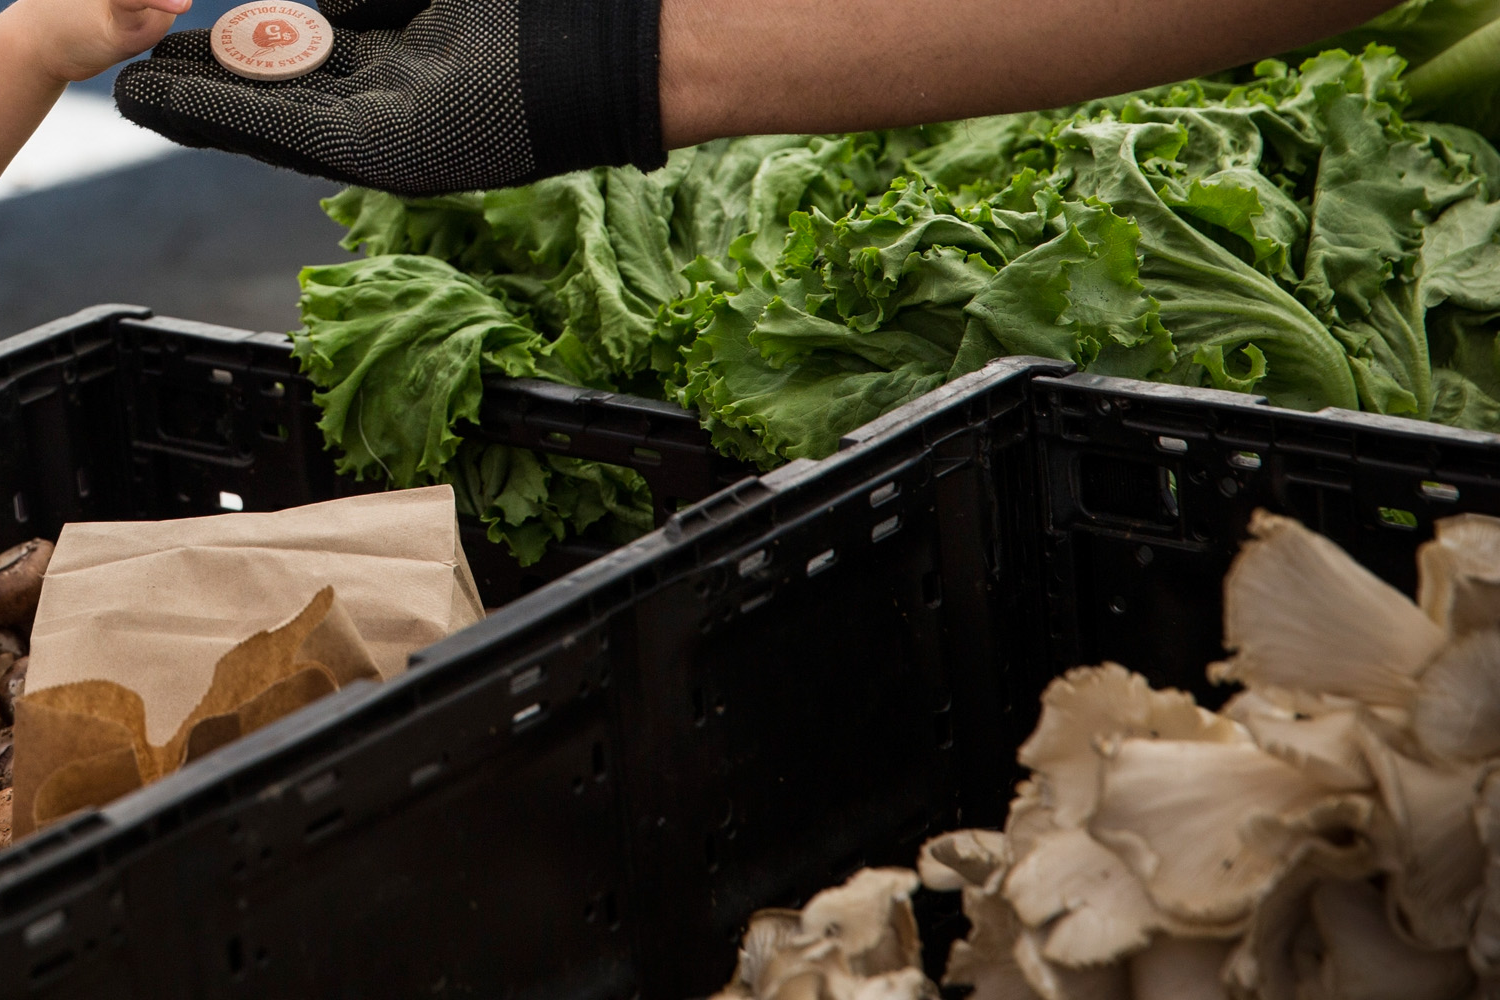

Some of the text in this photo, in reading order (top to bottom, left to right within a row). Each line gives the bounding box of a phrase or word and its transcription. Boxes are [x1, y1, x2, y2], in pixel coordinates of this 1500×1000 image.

[229, 5, 305, 26] FIVE DOLLARS
[305, 19, 320, 30] $5
[221, 28, 323, 68] FARMERS MARKET EBT
